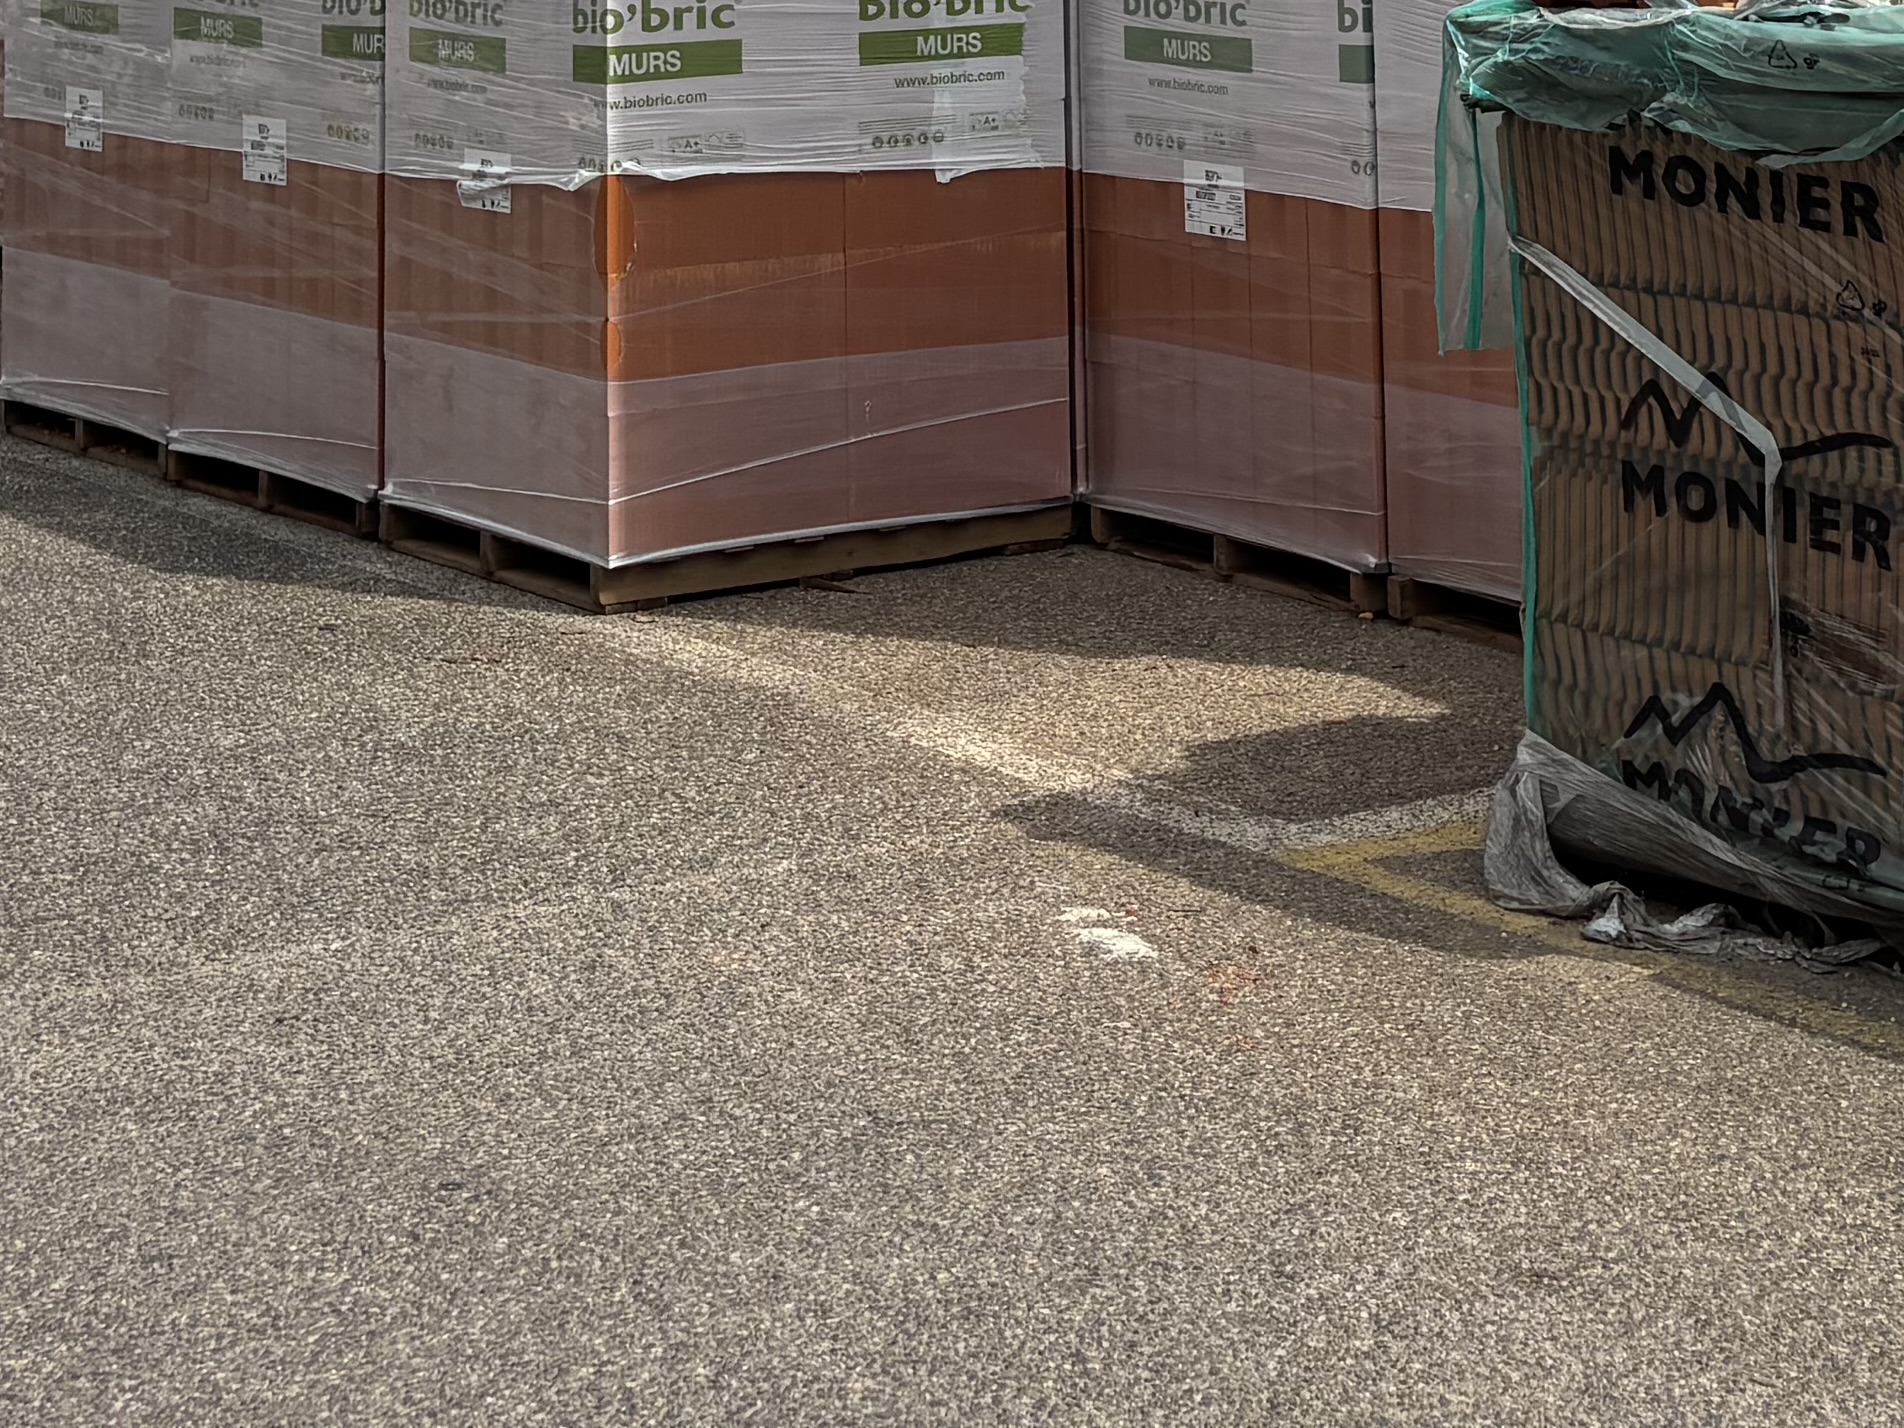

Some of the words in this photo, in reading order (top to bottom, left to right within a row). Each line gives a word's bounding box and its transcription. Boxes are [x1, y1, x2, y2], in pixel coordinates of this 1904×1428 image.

[63, 5, 94, 26] MURS
[200, 16, 234, 40] MURS
[437, 38, 475, 62] MURS
[915, 32, 983, 57] MURS
[1162, 37, 1213, 63] MURS
[608, 50, 683, 77] MURS
[893, 69, 1006, 89] www.biobric.com
[1148, 76, 1229, 96] www.biobric.com
[1606, 144, 1886, 243] MONIER
